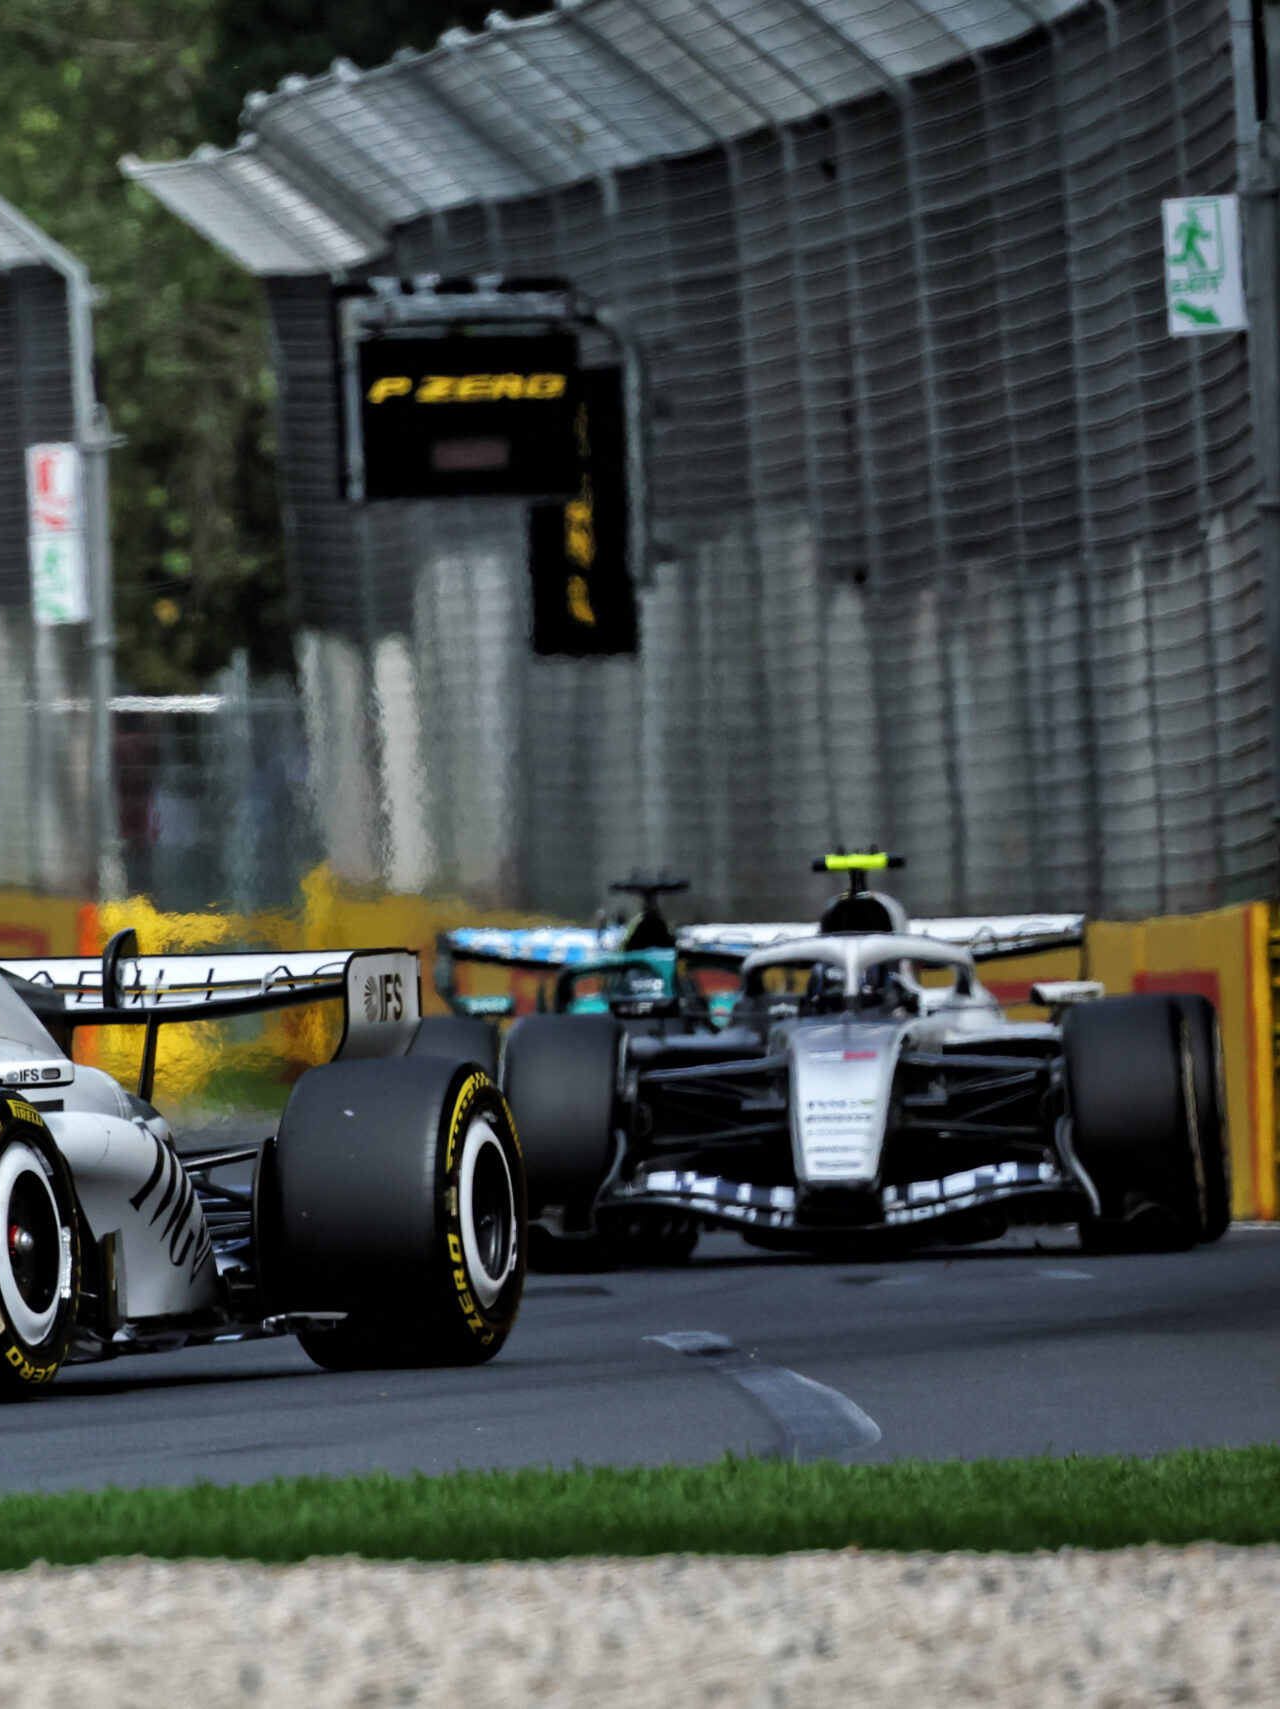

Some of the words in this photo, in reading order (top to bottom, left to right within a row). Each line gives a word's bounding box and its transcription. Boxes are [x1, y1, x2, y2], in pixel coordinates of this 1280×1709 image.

[368, 376, 413, 404] P
[415, 373, 568, 403] ZERO
[379, 973, 403, 1022] IFS
[20, 1068, 39, 1082] IFS
[447, 1233, 483, 1334] ZERO
